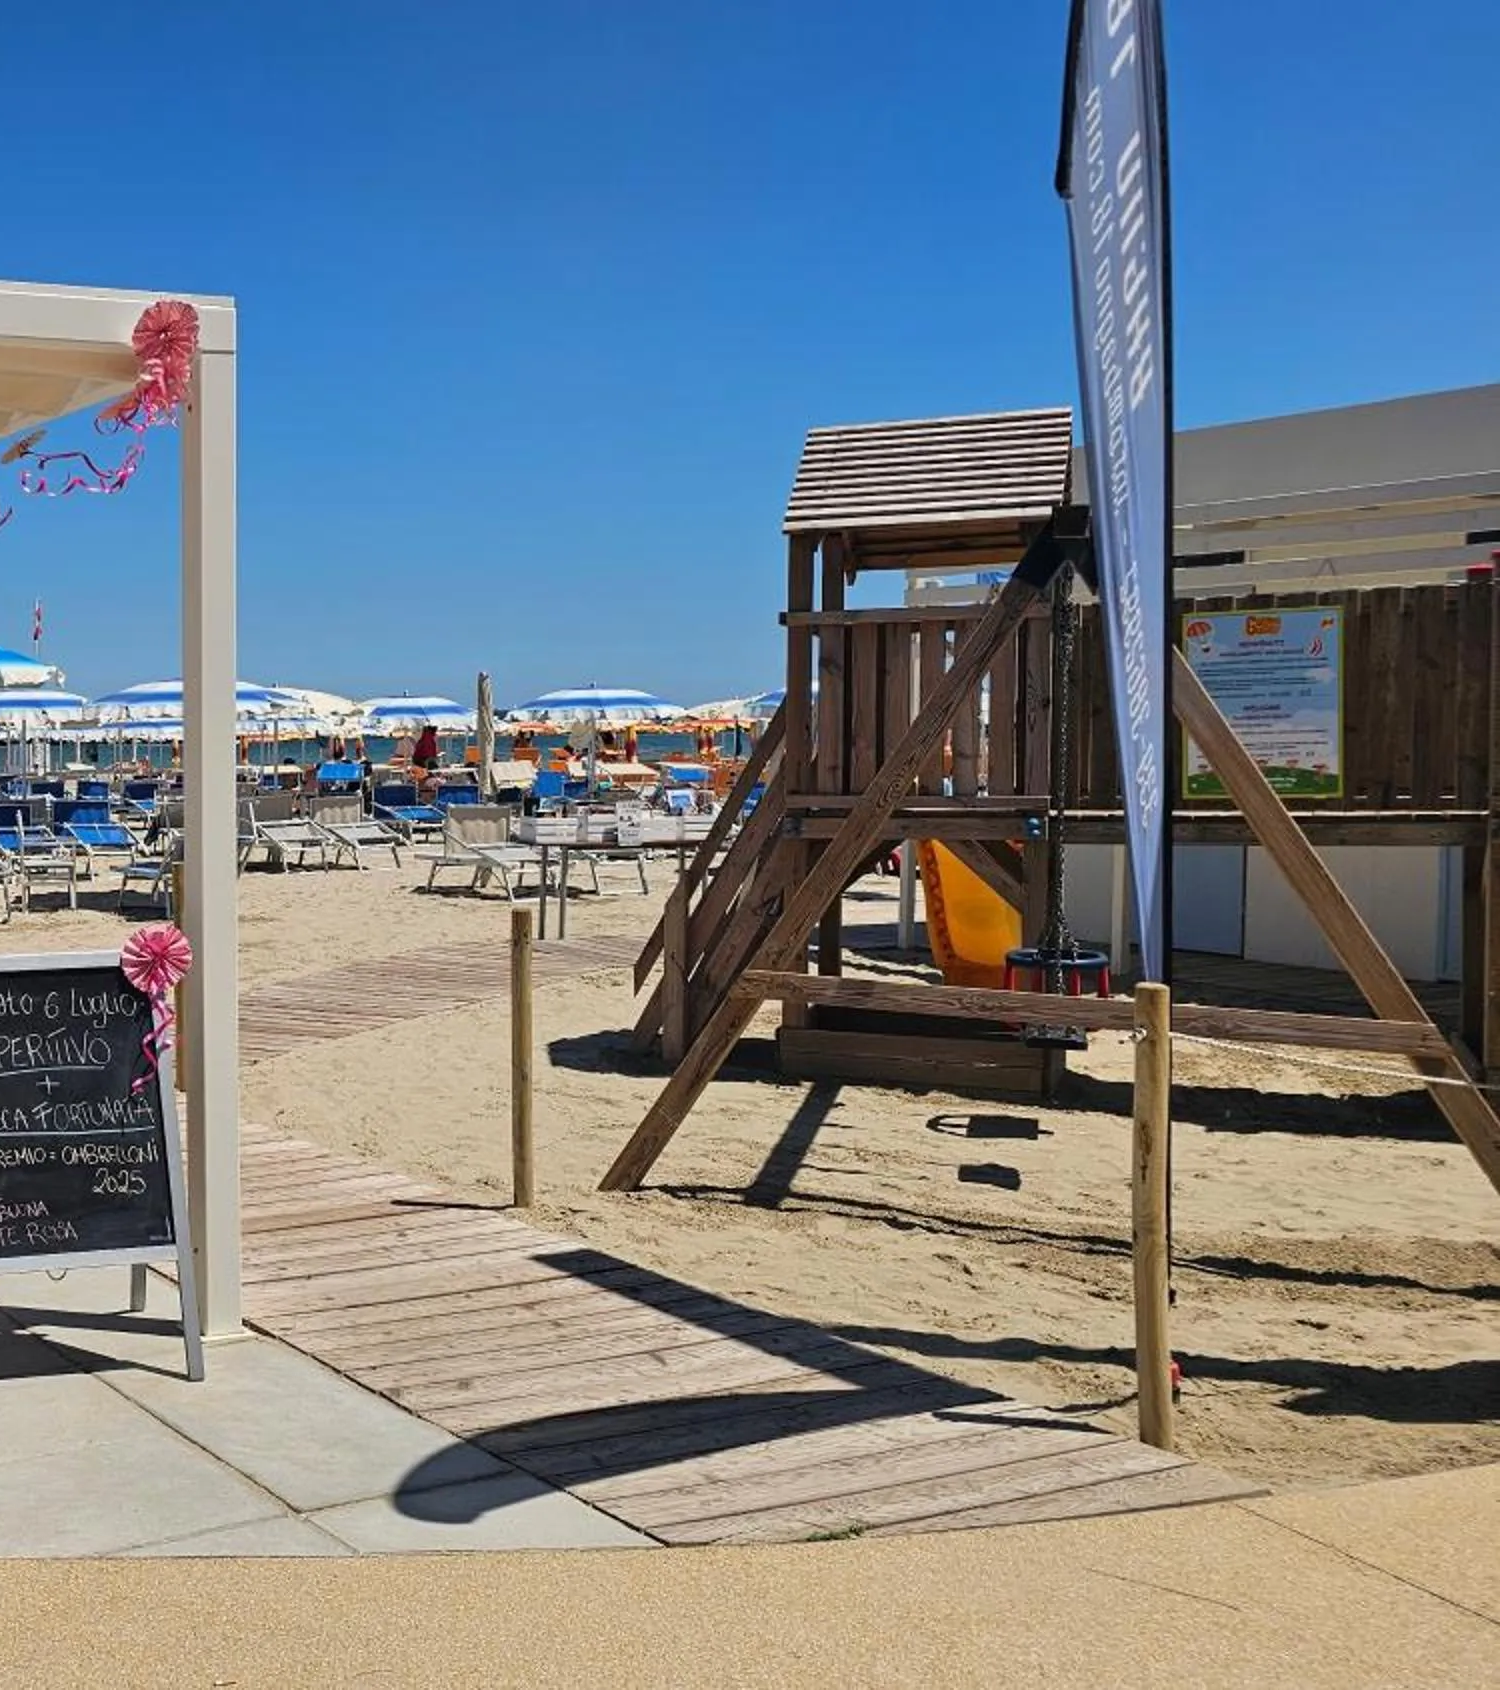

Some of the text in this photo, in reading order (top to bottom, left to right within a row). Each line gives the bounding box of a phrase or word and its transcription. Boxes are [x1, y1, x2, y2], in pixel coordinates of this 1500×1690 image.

[44, 991, 60, 1019] 6
[71, 987, 137, 1029] Luglio
[31, 1096, 156, 1131] FORTUNATA
[61, 1138, 159, 1166] OMBRELLONI
[92, 1167, 146, 1195] 2025
[25, 1221, 79, 1246] ROSA
